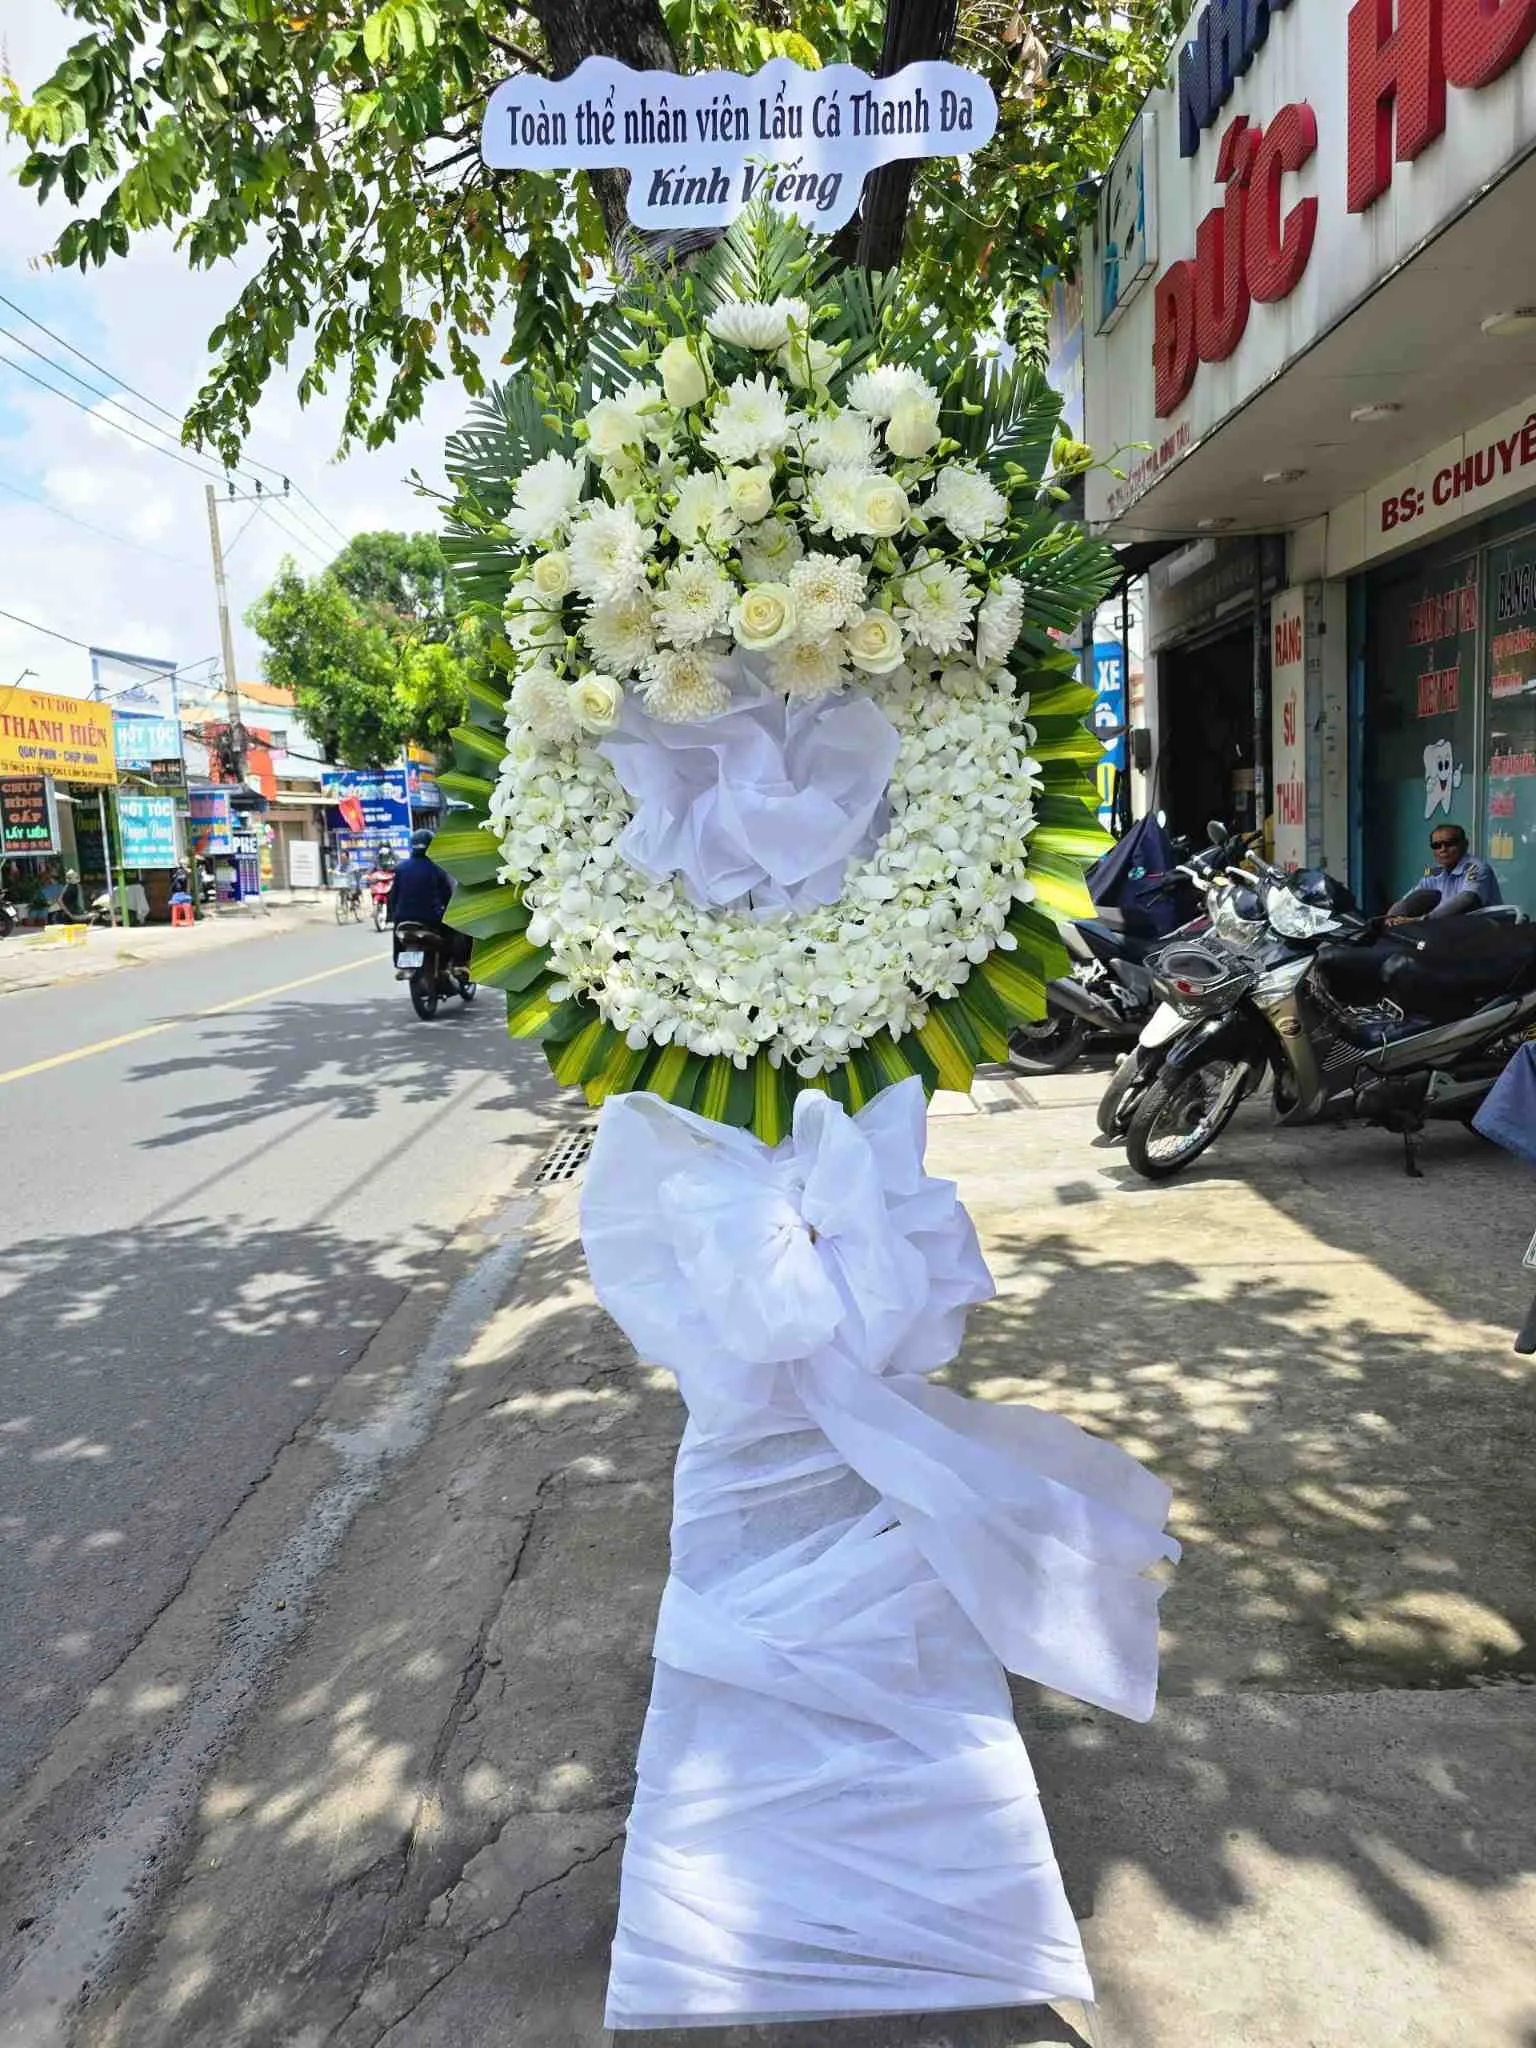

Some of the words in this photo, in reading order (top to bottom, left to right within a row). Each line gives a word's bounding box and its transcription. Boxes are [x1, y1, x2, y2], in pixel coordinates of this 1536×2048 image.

[507, 100, 567, 146] Toàn
[575, 84, 616, 146] thể
[624, 96, 688, 145] nhân
[696, 103, 750, 142] viên
[759, 79, 804, 140] Lẩu
[812, 88, 841, 138] Cá
[849, 88, 930, 136] Thanh
[940, 89, 974, 134] Đa
[646, 164, 730, 208] Kính
[740, 156, 843, 212] Viếng
[1152, 102, 1319, 419] ĐỨC
[1381, 487, 1424, 532] BS:
[1097, 659, 1121, 692] XE
[0, 714, 64, 744] THANH
